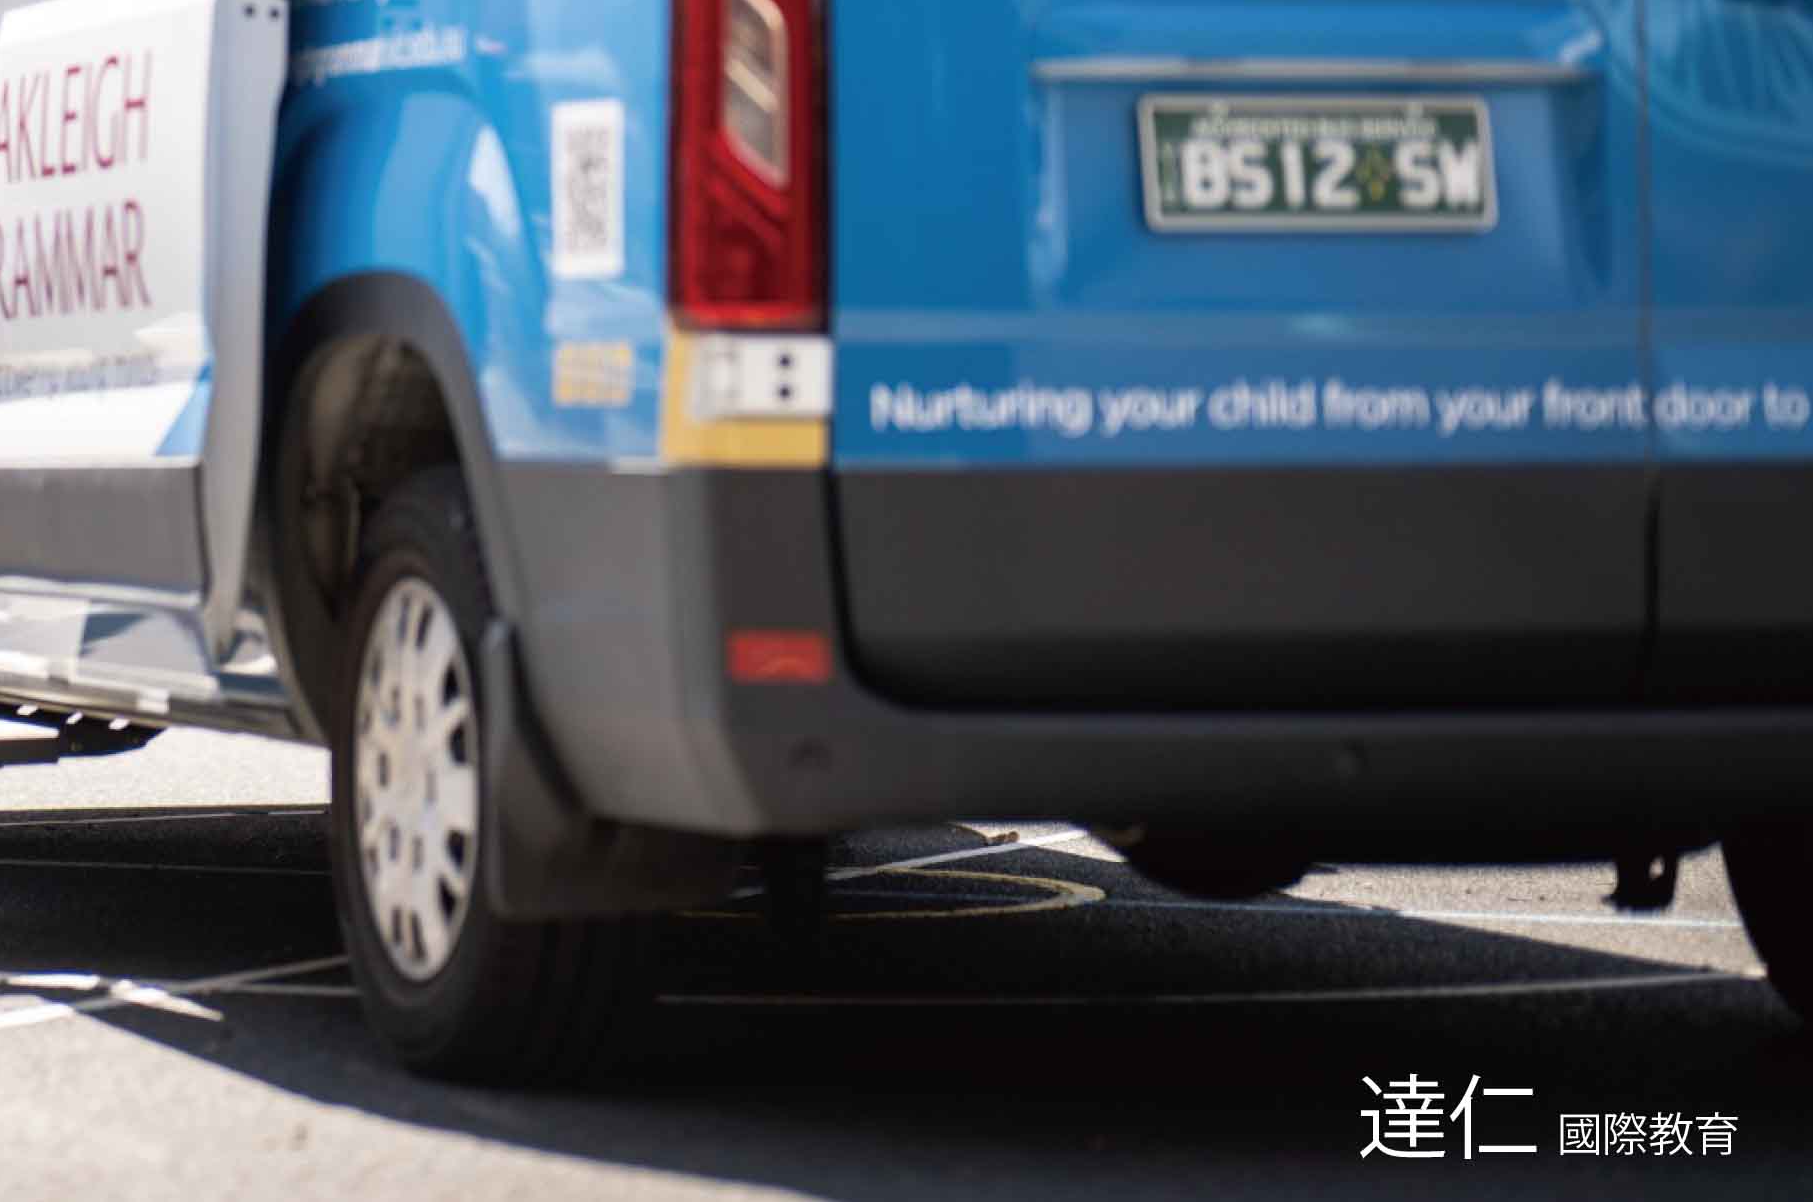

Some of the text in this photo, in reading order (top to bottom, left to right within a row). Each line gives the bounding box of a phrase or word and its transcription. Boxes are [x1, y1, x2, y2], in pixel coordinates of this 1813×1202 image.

[871, 376, 1810, 438] Nurturing your child from your front door to
